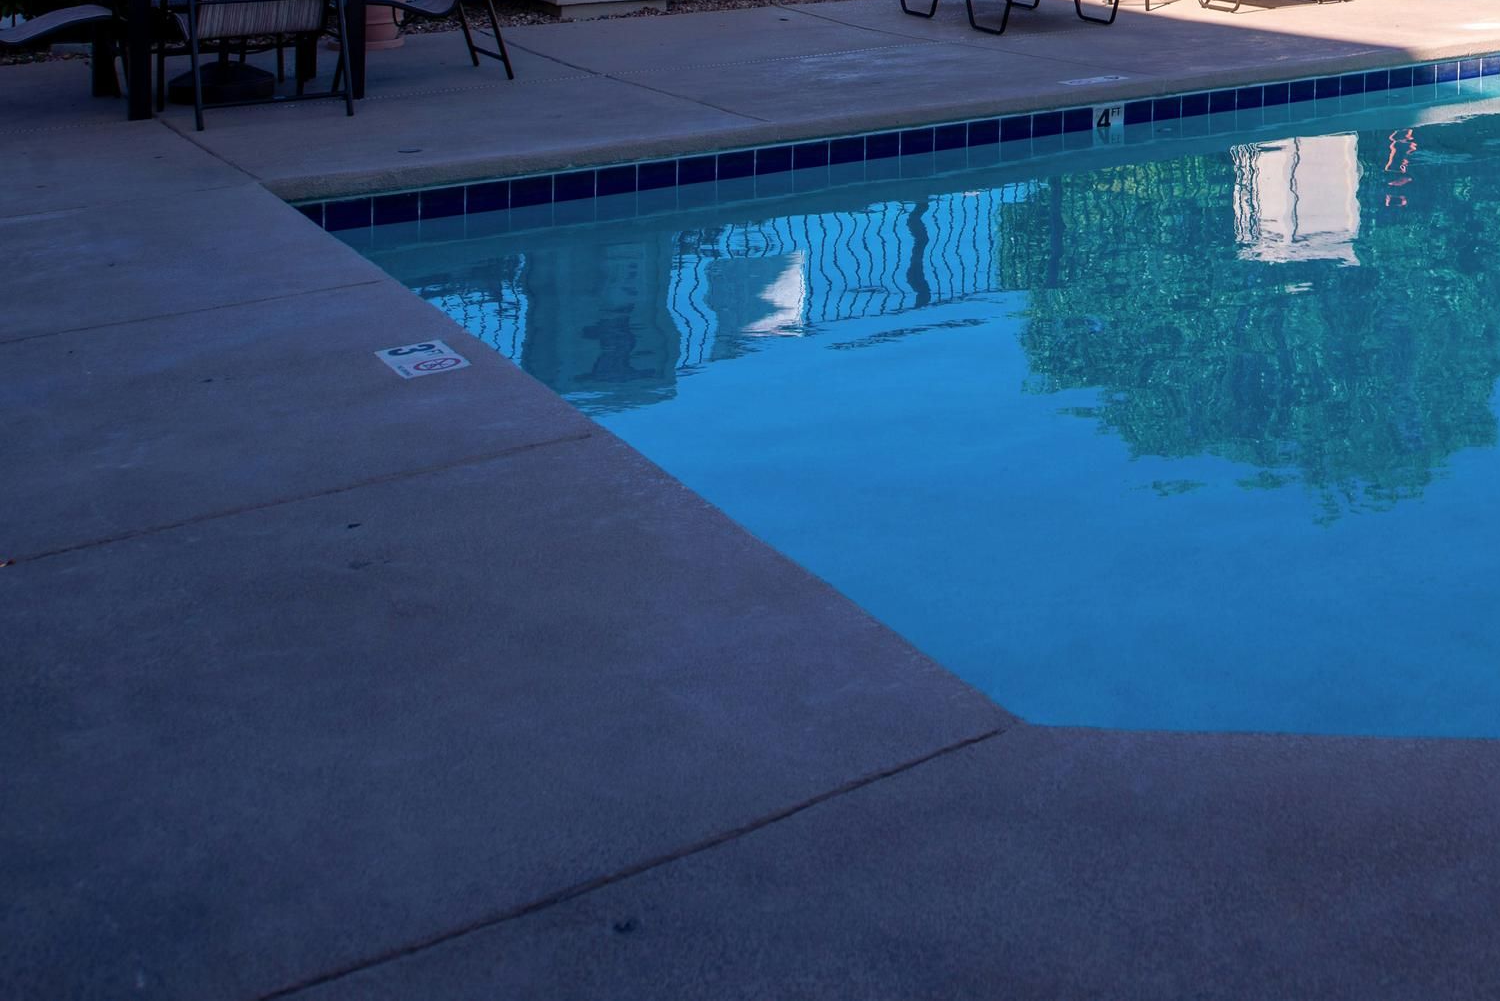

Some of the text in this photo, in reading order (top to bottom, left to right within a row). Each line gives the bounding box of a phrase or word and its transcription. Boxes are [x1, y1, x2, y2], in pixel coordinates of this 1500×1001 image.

[1097, 107, 1120, 127] 4 FT
[388, 343, 436, 356] 3
